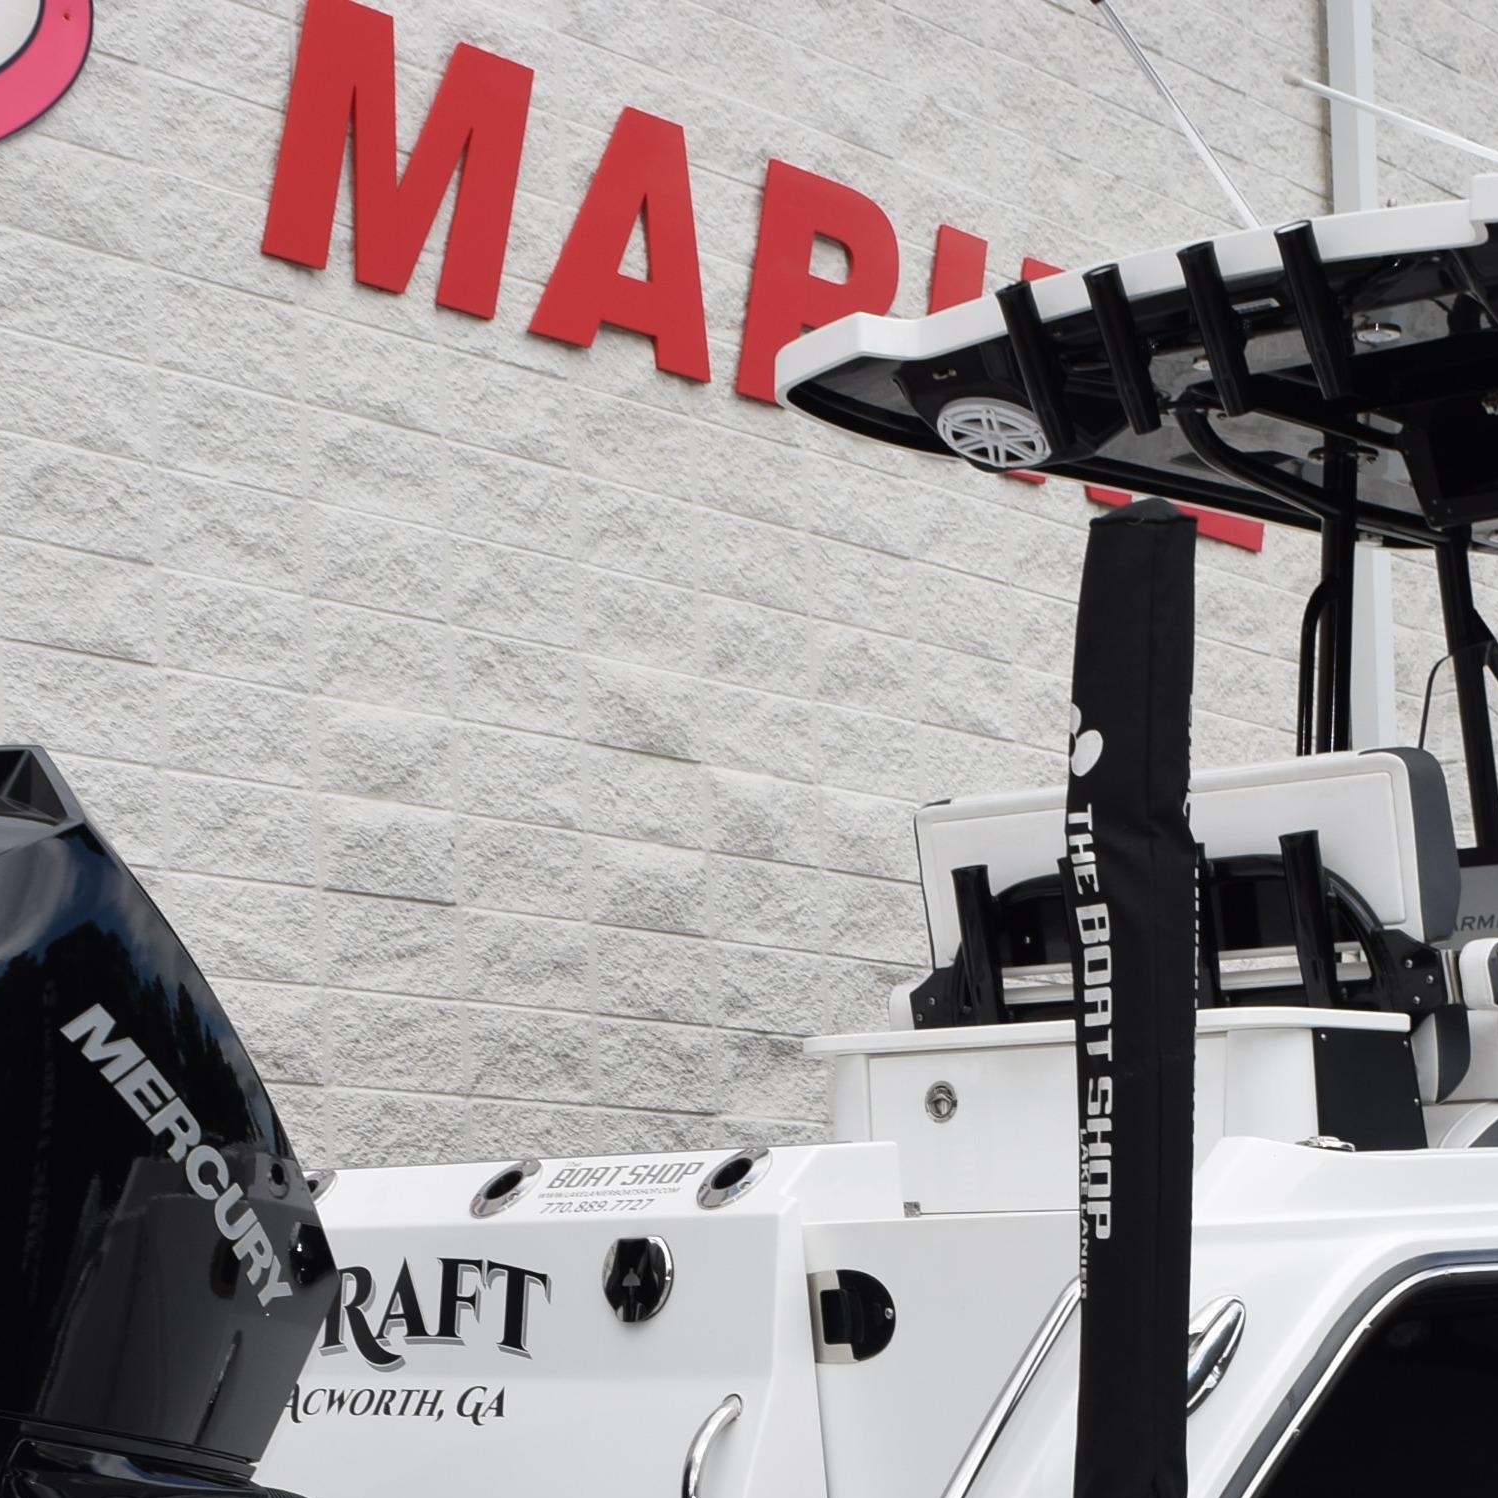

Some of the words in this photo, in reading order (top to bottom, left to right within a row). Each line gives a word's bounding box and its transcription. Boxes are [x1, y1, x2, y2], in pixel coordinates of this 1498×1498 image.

[1068, 803, 1100, 895] THE
[1076, 903, 1112, 1062] BOAT
[59, 1003, 293, 1307] MERCURY
[546, 1165, 629, 1189] BOAT
[620, 1162, 705, 1186] SHOP
[1079, 1128, 1090, 1197] LAKE
[1087, 1076, 1112, 1240] SHOP
[539, 1198, 655, 1215] 770.889.7727
[285, 1383, 445, 1424] ACWORTH,
[456, 1386, 506, 1426] GA
